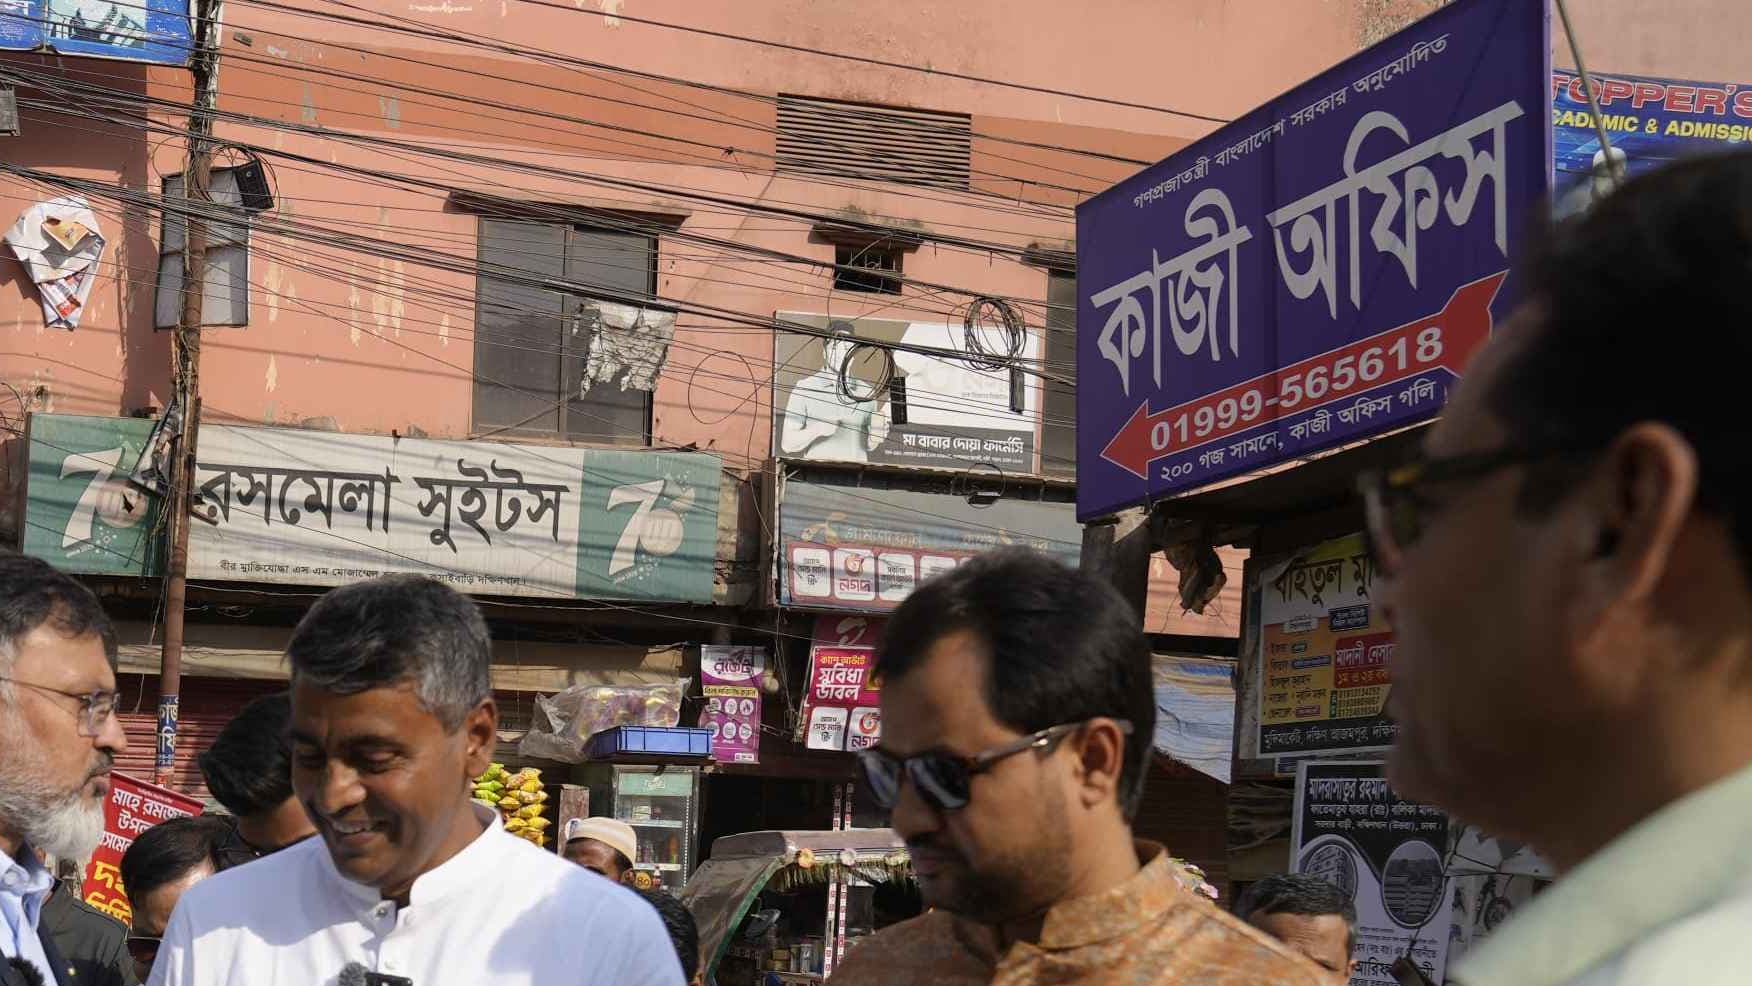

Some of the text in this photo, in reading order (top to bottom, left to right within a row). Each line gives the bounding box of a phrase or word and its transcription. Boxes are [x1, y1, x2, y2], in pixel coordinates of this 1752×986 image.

[1552, 74, 1752, 118] TOPPER'S
[1133, 33, 1450, 209] গণপ্রজাতন্ত্রী বাংলাদেশ সরকার অনুমোদিত
[1645, 118, 1658, 133] &
[1090, 100, 1525, 397] কাজী অফিস
[1151, 325, 1444, 451] 01999-565618
[902, 433, 915, 447] মা
[918, 434, 950, 449] বাবার
[953, 437, 981, 453] দোয়া
[1160, 460, 1193, 482] ২০০
[1199, 449, 1225, 469] গজ
[1230, 430, 1284, 459] সামনে,
[1290, 409, 1333, 441] কাজী
[1337, 393, 1391, 426] অফিস
[196, 458, 570, 553] রসমেলা সুইটস
[816, 684, 861, 701] ডাবল
[819, 663, 864, 684] সুবিধা
[112, 788, 143, 812] মাহে
